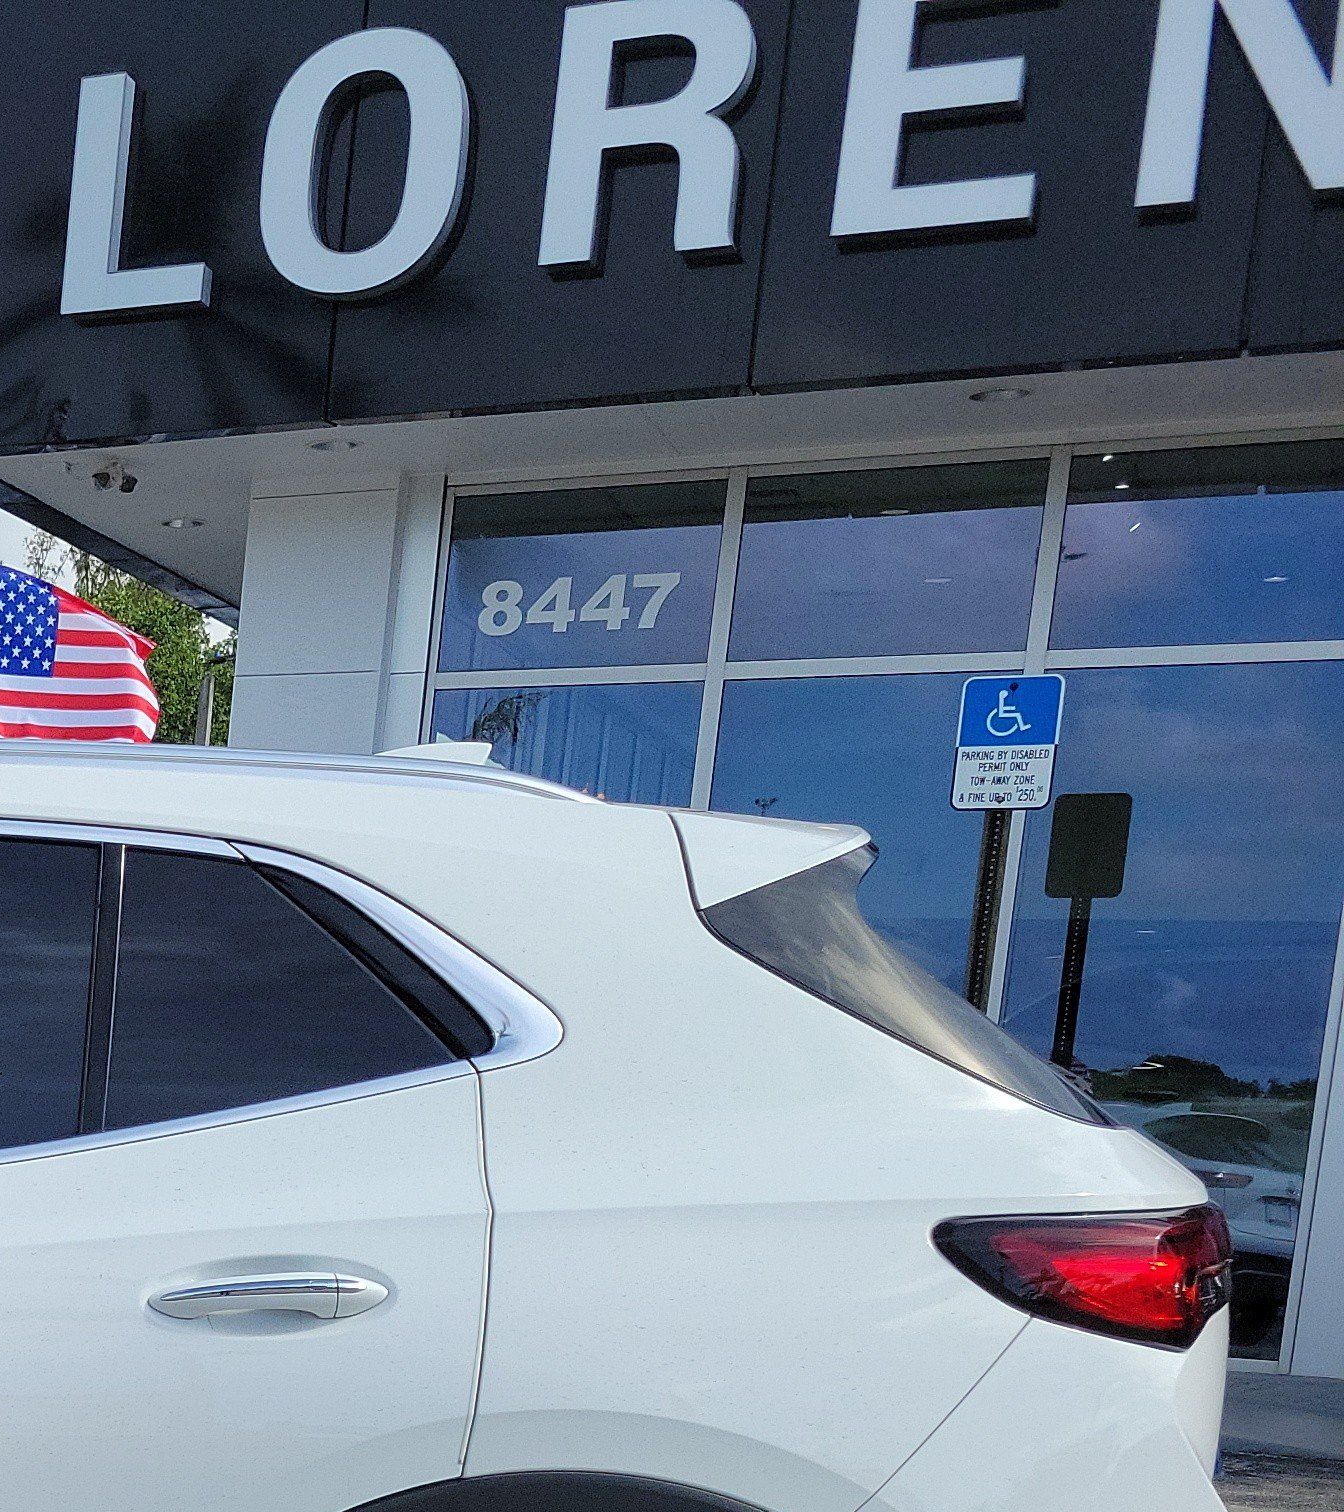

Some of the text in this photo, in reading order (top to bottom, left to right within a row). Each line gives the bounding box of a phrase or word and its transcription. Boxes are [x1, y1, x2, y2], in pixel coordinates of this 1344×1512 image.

[60, 0, 1344, 314] LOREN
[477, 572, 682, 637] 8447
[961, 749, 1050, 760] PARKING BY DISABLED
[978, 761, 1030, 772] PERMIT ONLY
[970, 775, 1036, 786] TOW-AWAY ZONE
[968, 792, 986, 802] FINE
